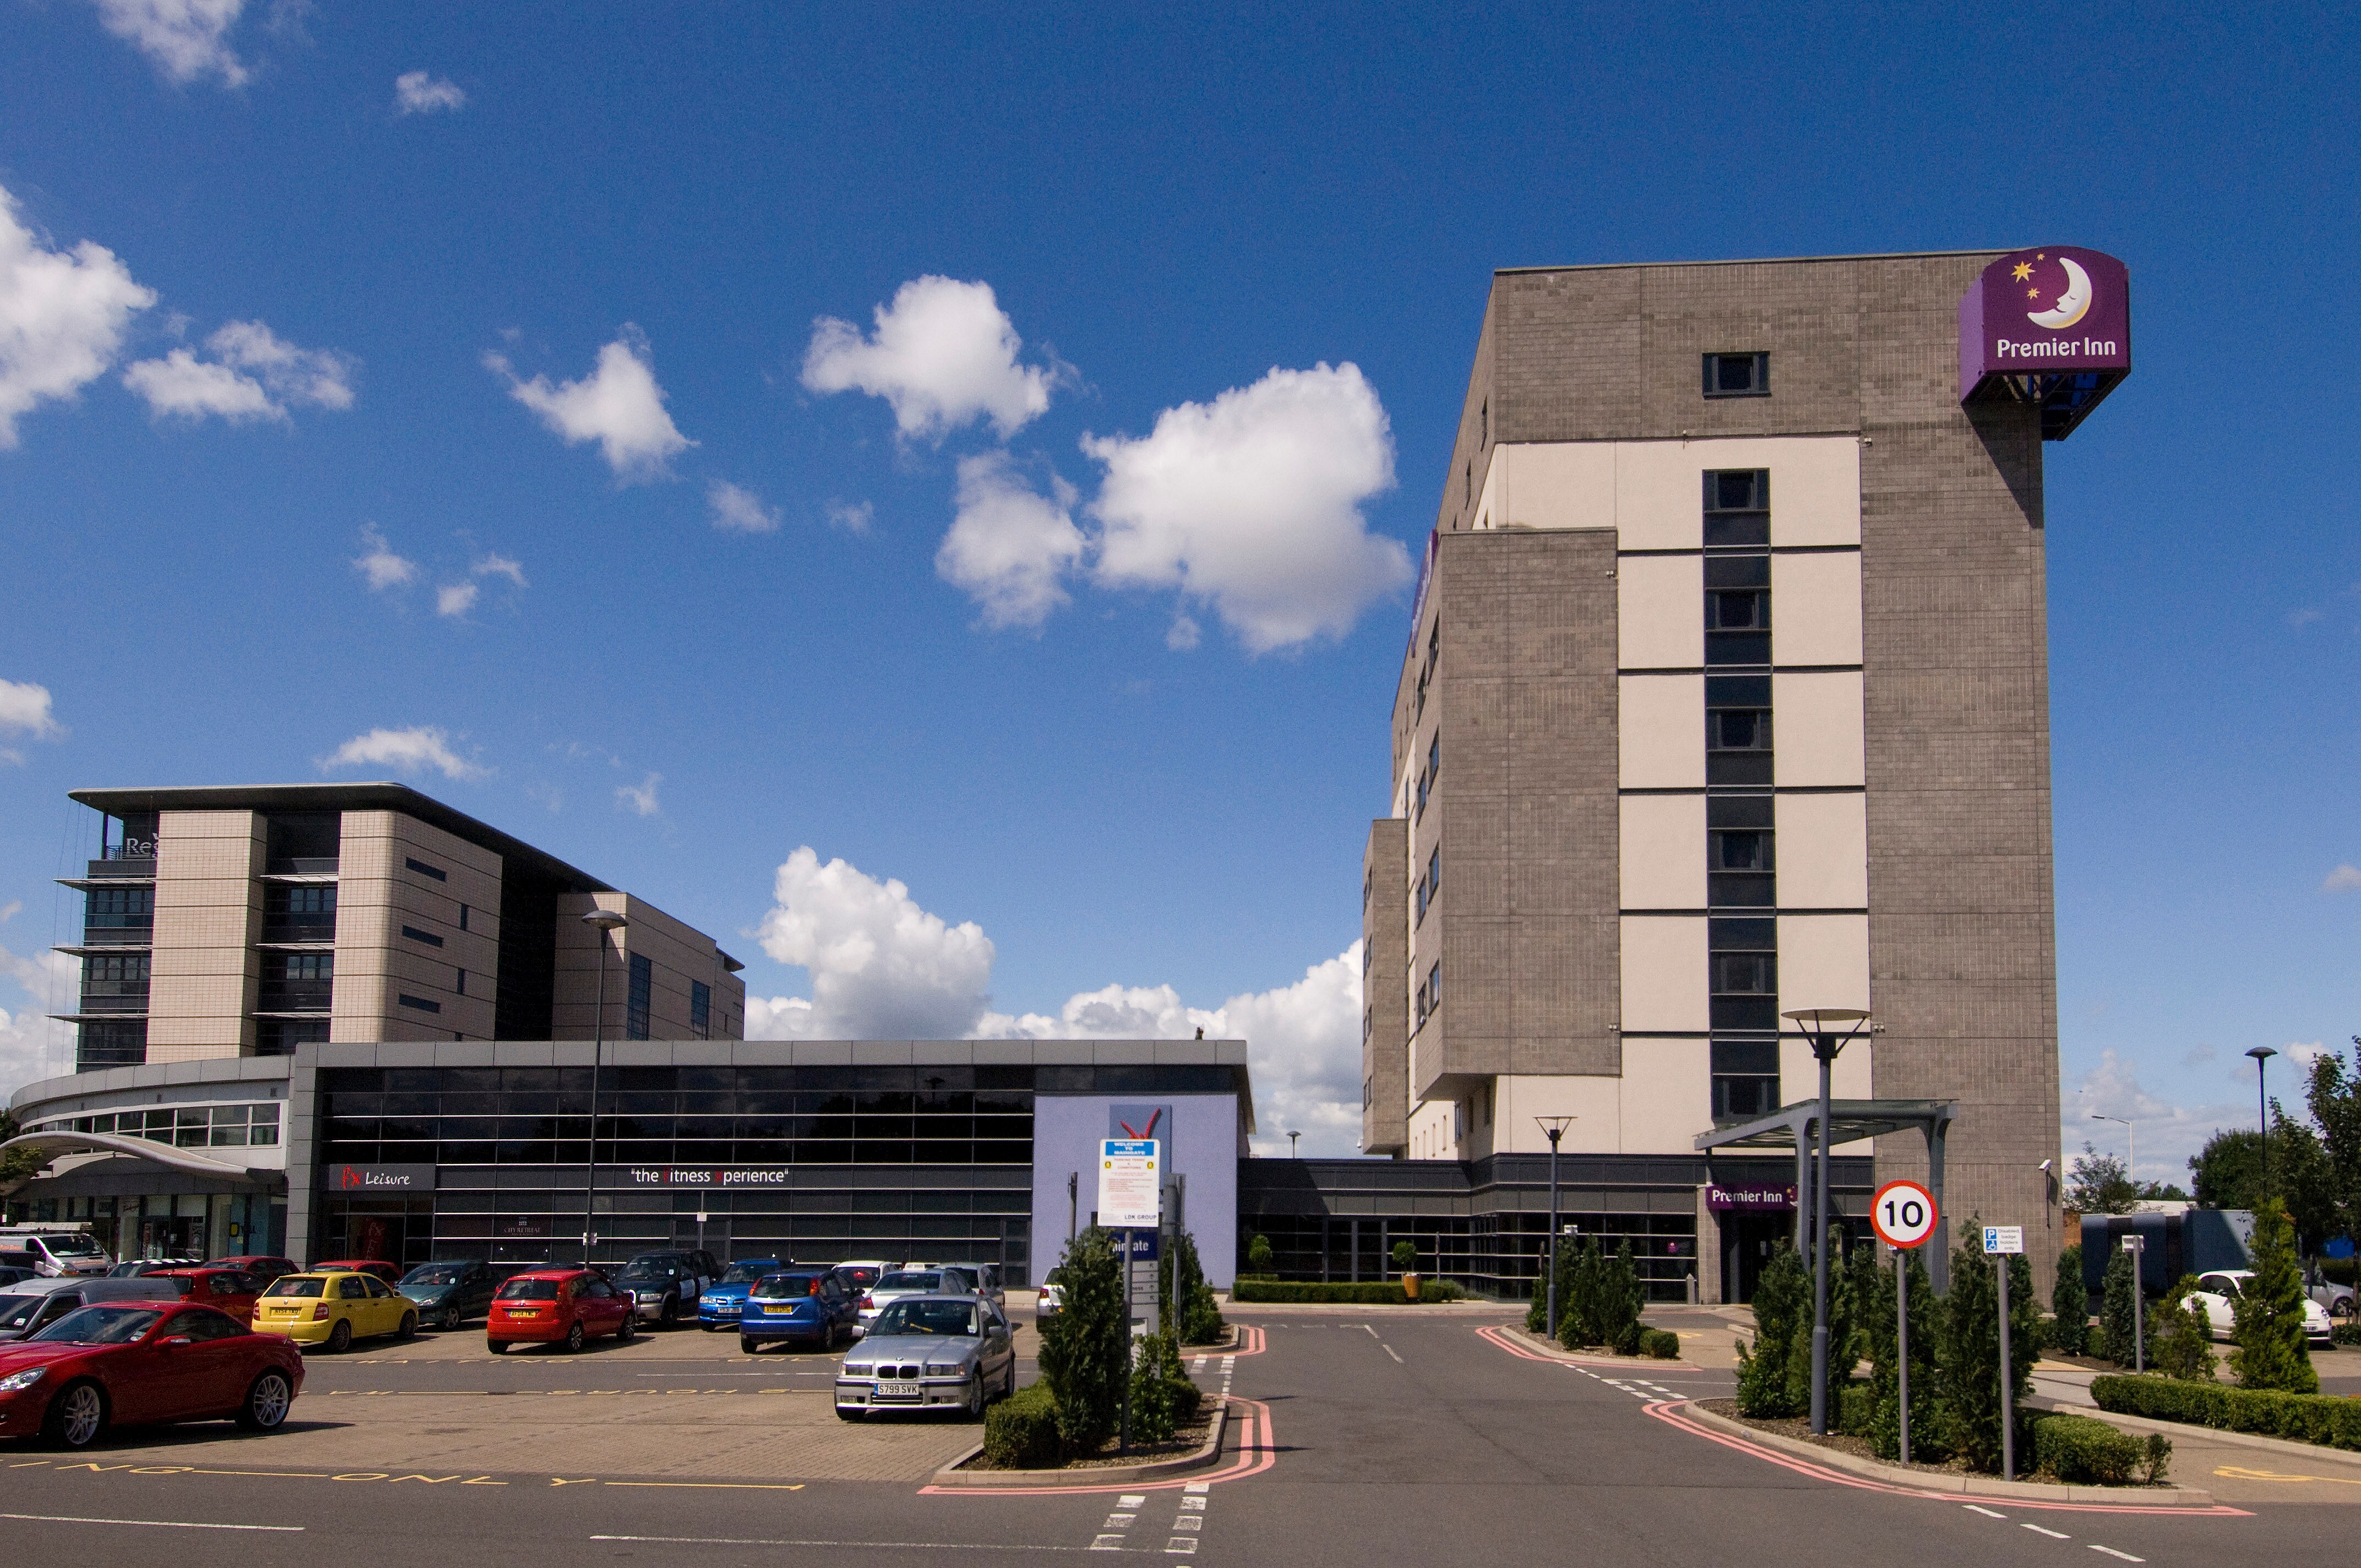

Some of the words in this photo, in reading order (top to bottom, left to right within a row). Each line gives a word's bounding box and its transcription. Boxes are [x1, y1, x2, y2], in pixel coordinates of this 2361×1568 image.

[1997, 337, 2080, 358] Premier
[2084, 337, 2116, 356] Inn
[366, 1172, 411, 1185] Leisure
[1712, 1190, 1761, 1202] Premier
[1763, 1191, 1782, 1202] Inn
[1885, 1200, 1924, 1228] 10
[1988, 1230, 1995, 1239] P
[1112, 1240, 1149, 1253] ainate
[879, 1385, 900, 1393] S799
[901, 1385, 917, 1393] SVK
[0, 1459, 195, 1474] ING
[331, 1473, 596, 1487] ONLY
